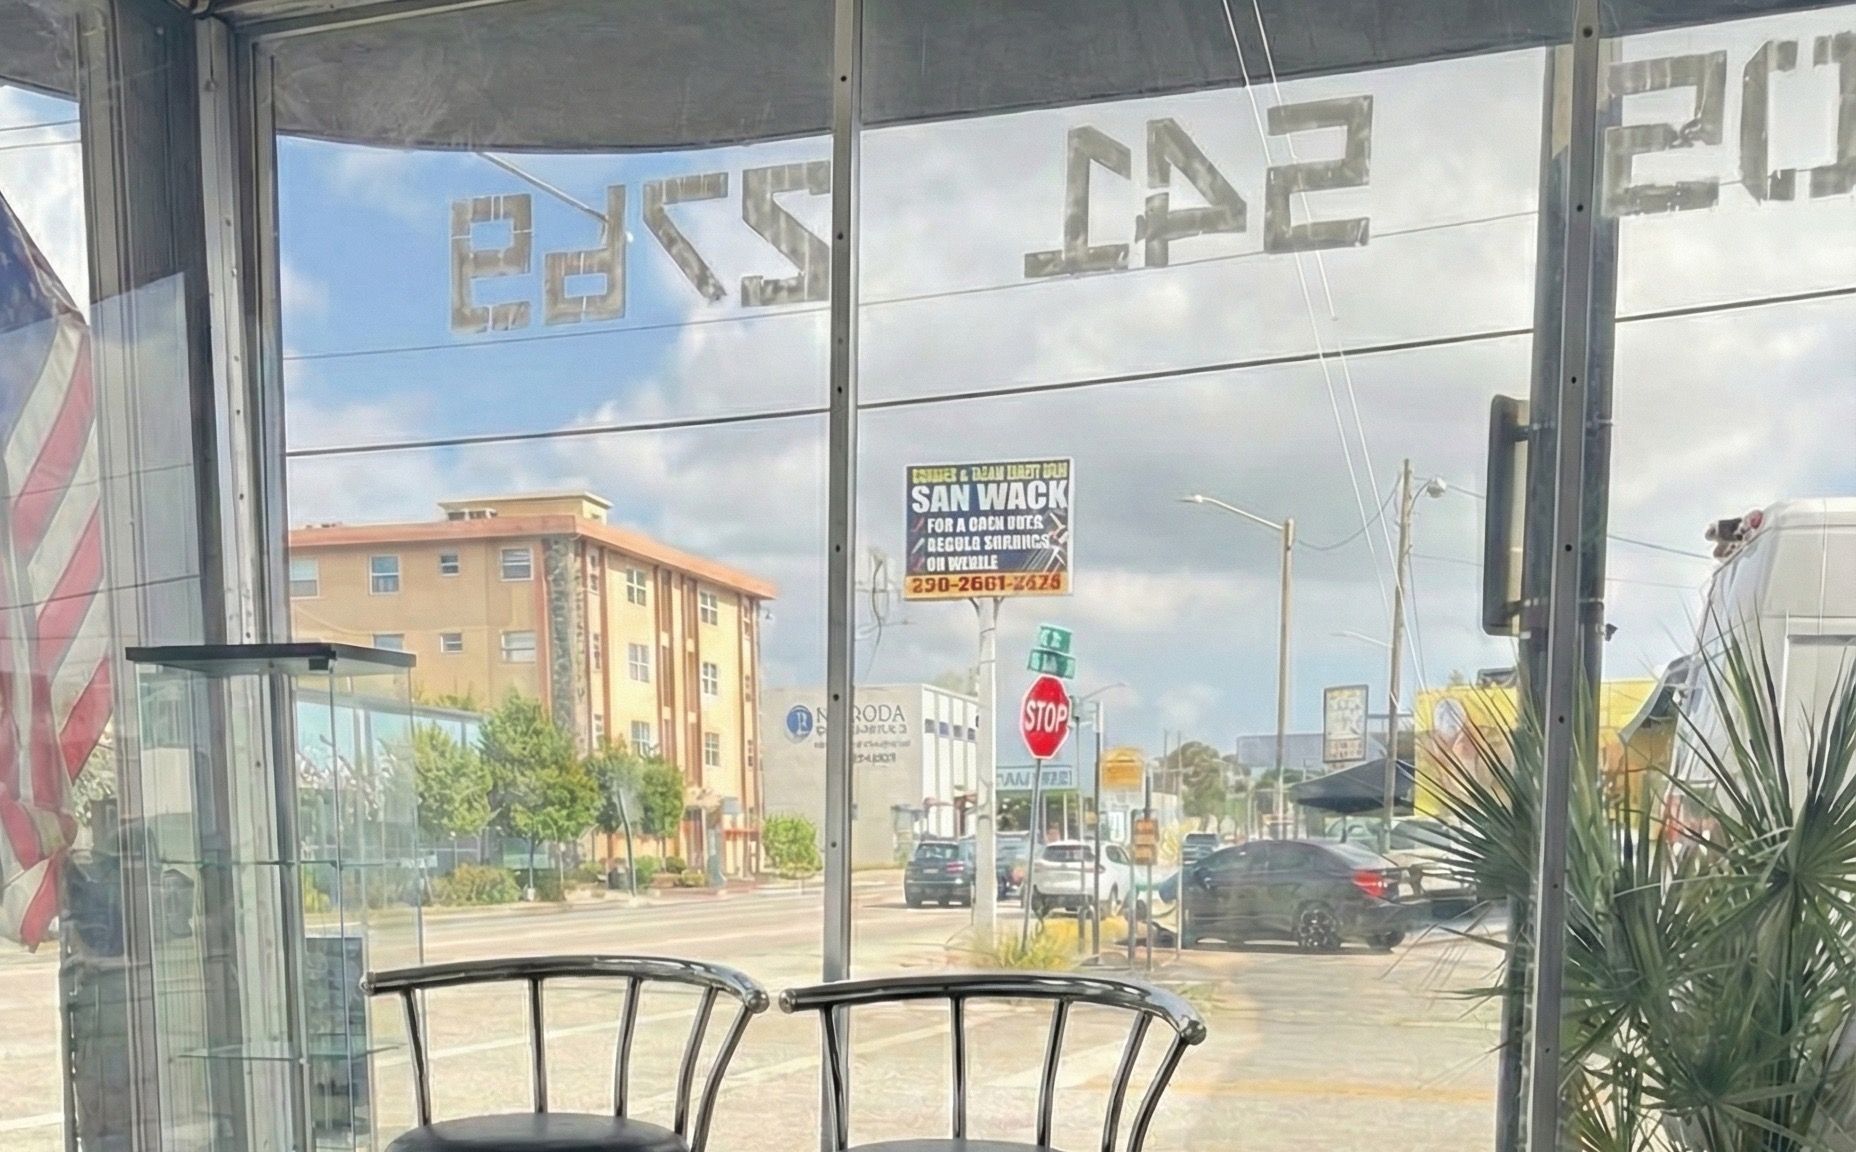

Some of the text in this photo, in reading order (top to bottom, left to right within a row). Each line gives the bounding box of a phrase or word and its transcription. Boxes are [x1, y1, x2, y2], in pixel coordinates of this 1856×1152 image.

[911, 480, 1068, 513] SAN WACK
[927, 517, 954, 533] FOR
[956, 517, 966, 532] A
[816, 704, 906, 722] NRODA
[1023, 700, 1068, 732] STOP
